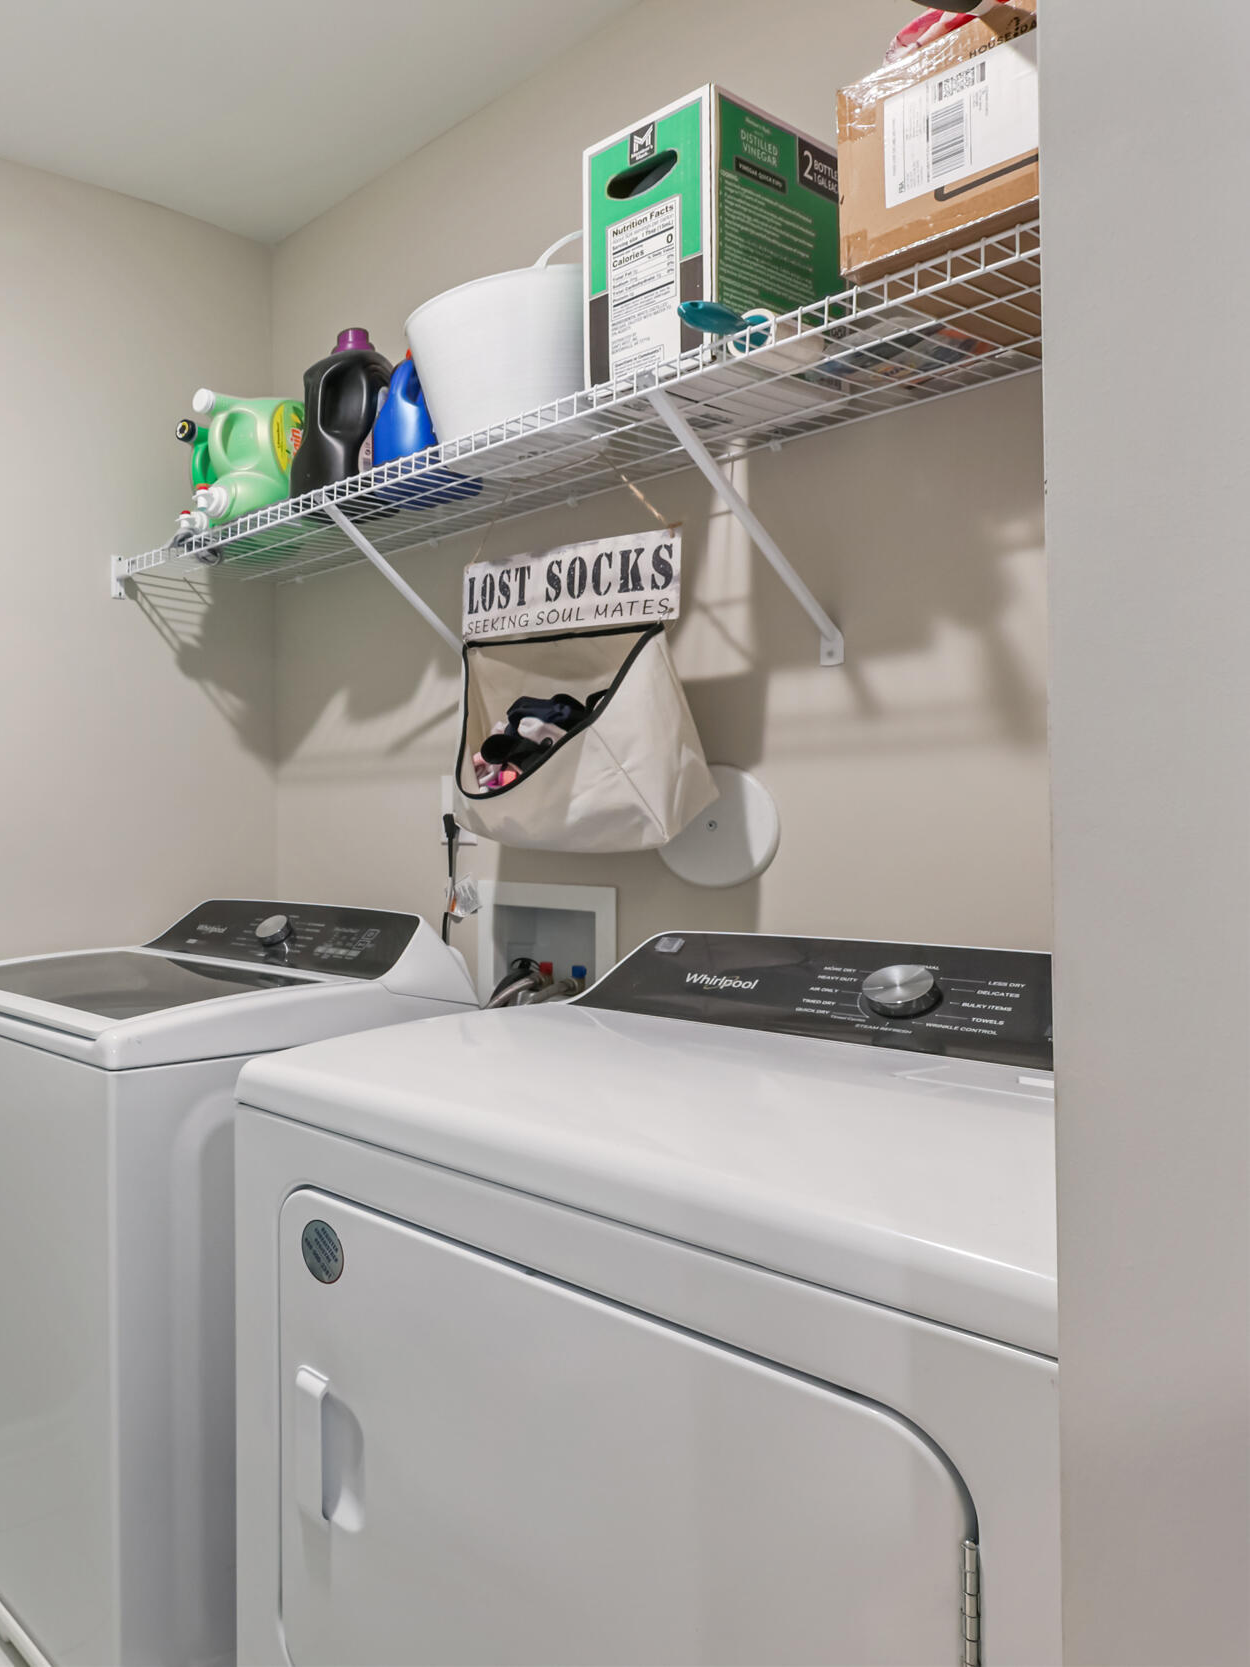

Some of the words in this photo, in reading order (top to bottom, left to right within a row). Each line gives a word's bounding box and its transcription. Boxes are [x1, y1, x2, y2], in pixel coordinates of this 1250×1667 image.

[740, 128, 778, 156] DISTILLED
[742, 142, 777, 167] VINEGAR
[803, 150, 813, 181] 2
[612, 216, 648, 238] Nutrition
[649, 204, 674, 220] Facts
[666, 233, 673, 244] 0
[612, 249, 645, 268] Calories
[467, 565, 531, 615] LOST
[545, 543, 674, 603] SOCKS
[467, 613, 530, 636] SEEKING
[535, 606, 585, 626] SOUL
[593, 597, 670, 619] MATES
[685, 972, 759, 990] Whirlpool
[976, 989, 1020, 998] DELICATES
[987, 1004, 1012, 1012] ITEMS
[925, 1022, 959, 1031] WRINKLE
[960, 1026, 998, 1036] CONTROL
[971, 1017, 1005, 1026] TOWELS
